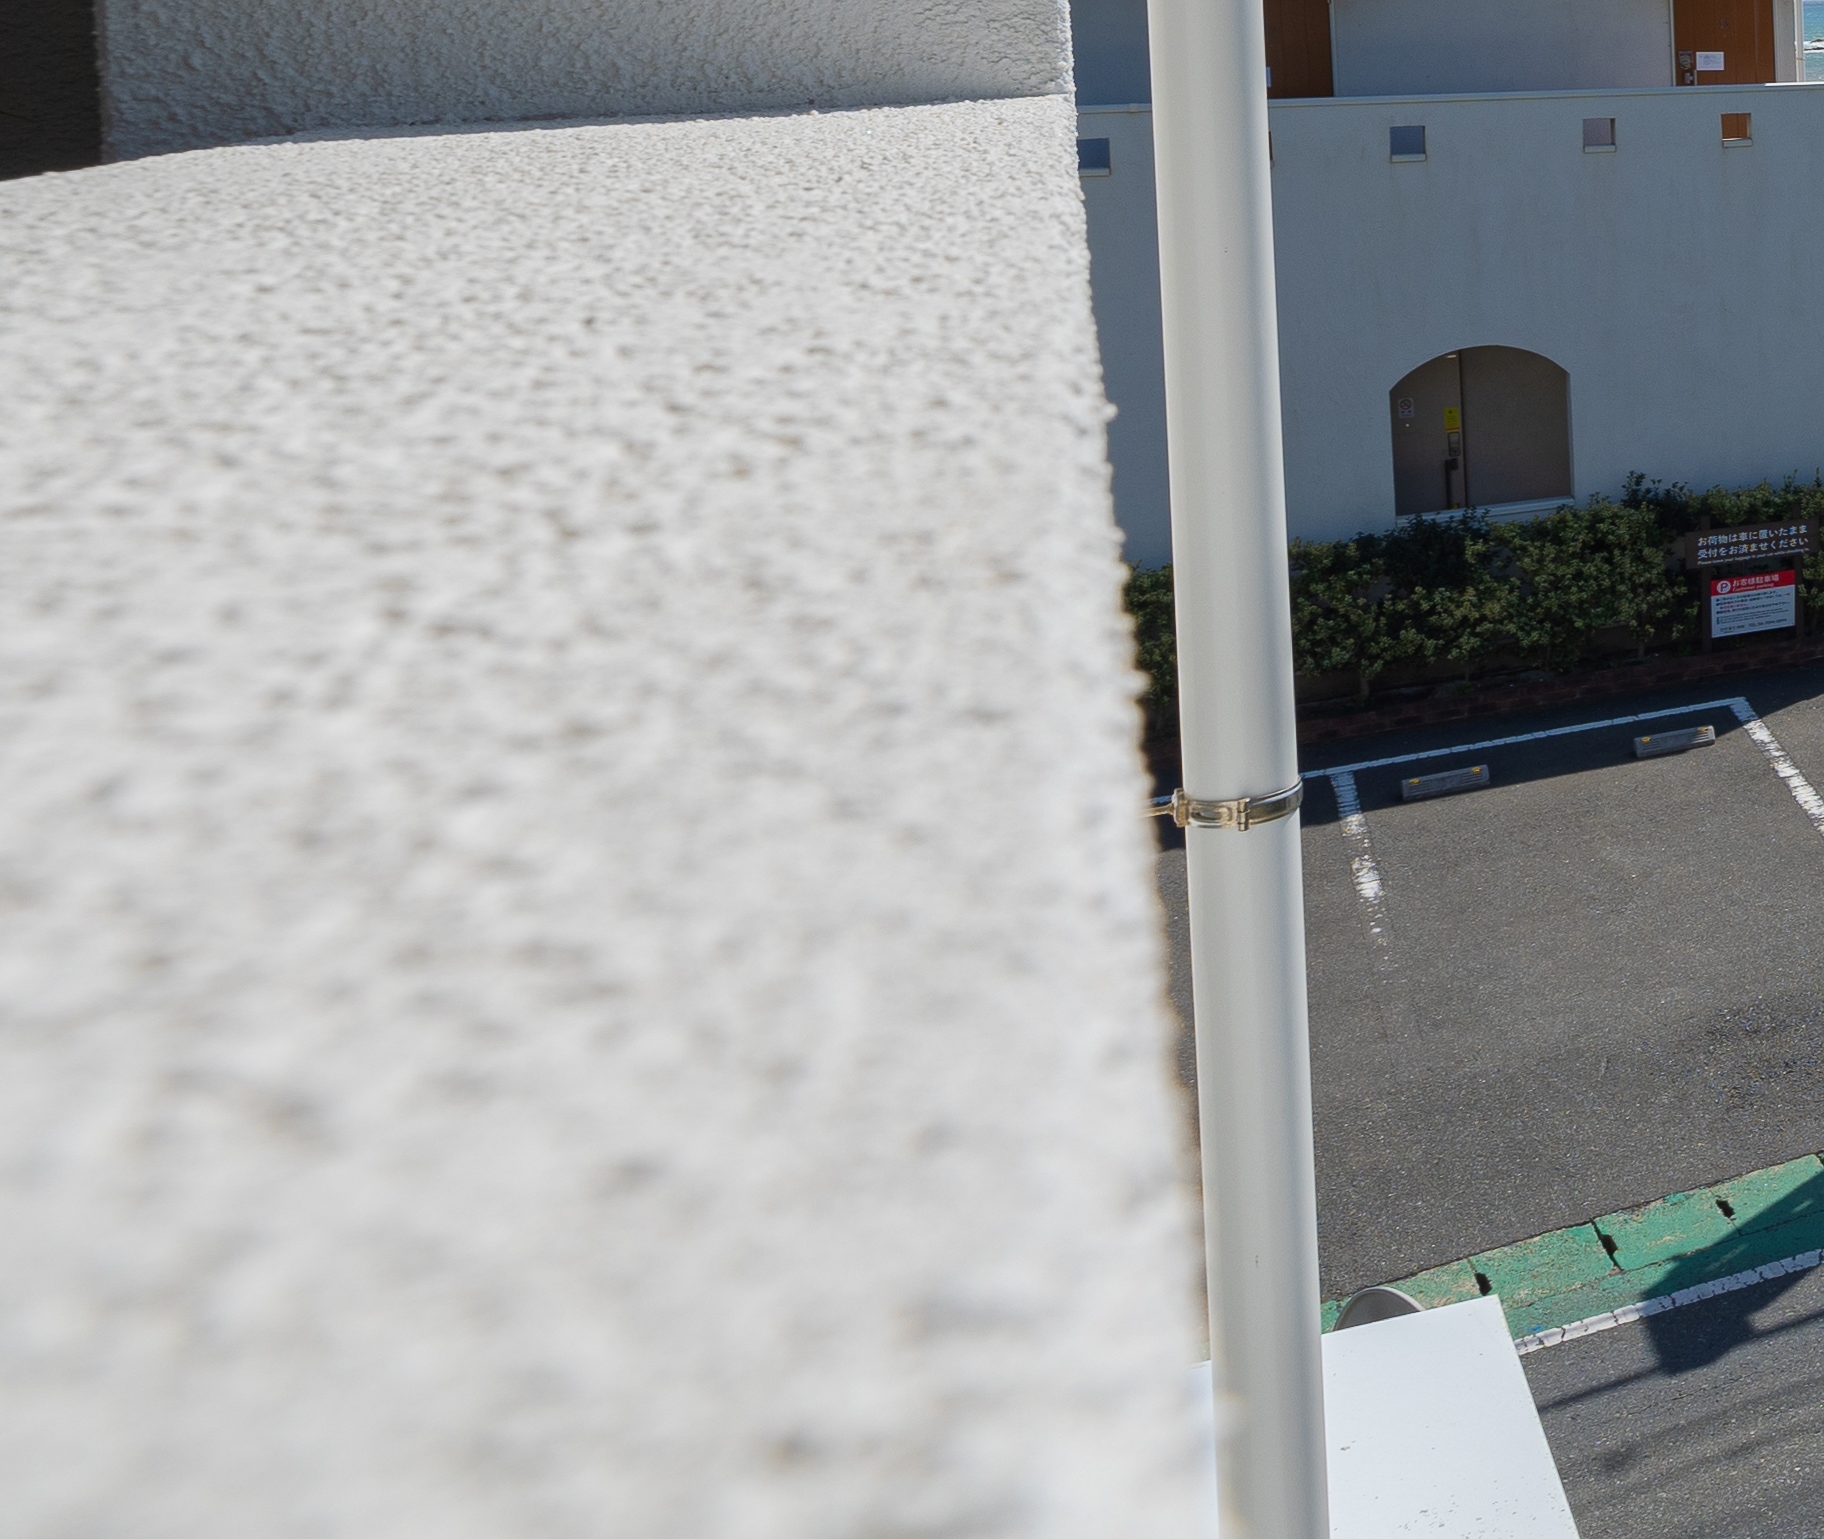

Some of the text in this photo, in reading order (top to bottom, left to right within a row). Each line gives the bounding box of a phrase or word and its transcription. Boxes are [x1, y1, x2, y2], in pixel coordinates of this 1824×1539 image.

[1697, 525, 1808, 547] お荷物は車に置いたまま
[1697, 537, 1809, 560] 受付をお済ませください
